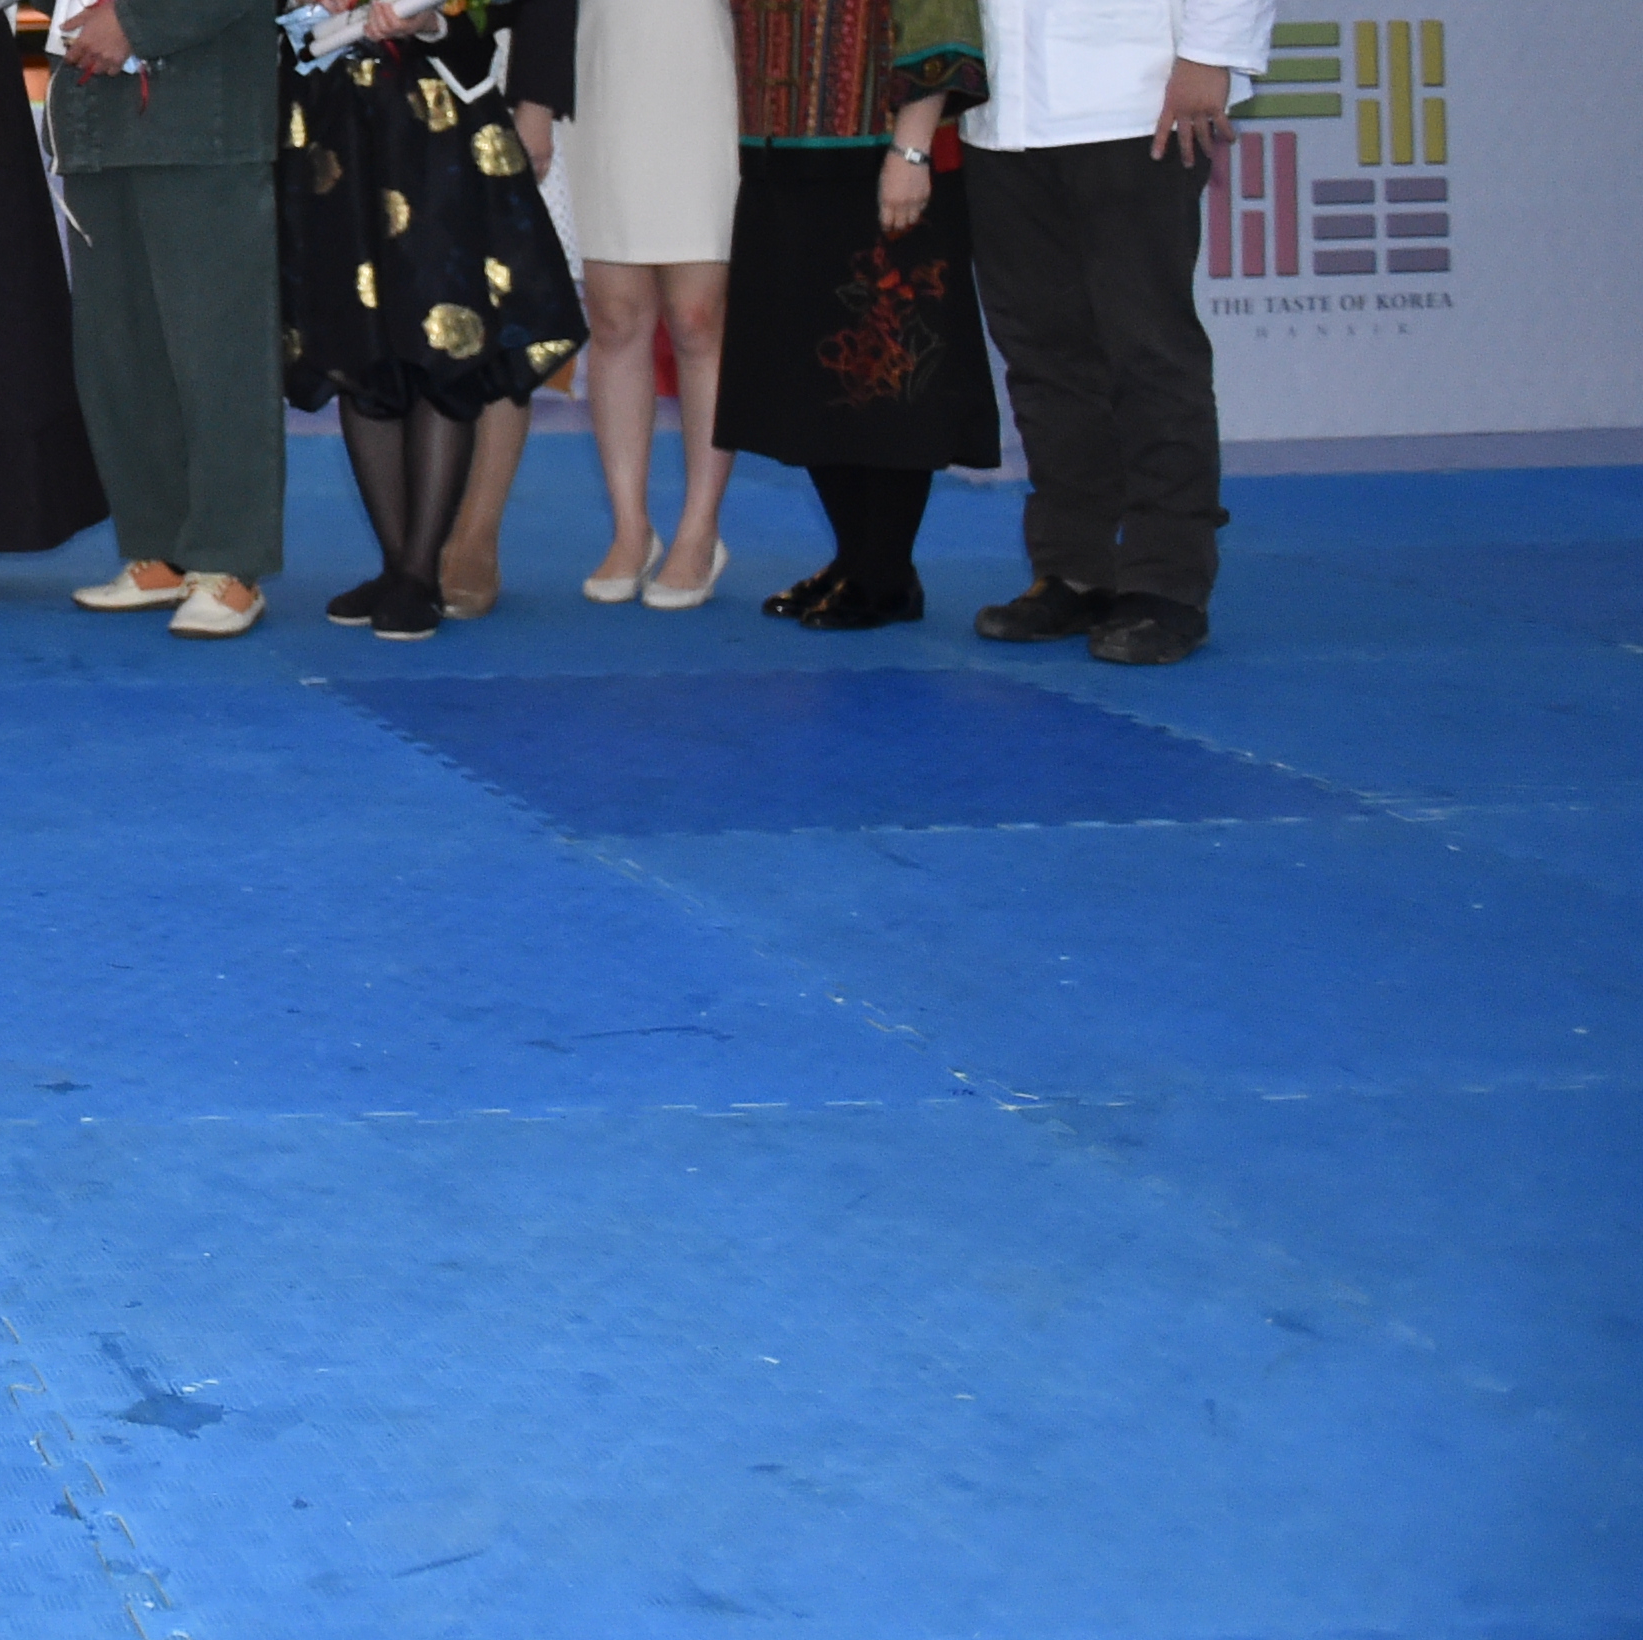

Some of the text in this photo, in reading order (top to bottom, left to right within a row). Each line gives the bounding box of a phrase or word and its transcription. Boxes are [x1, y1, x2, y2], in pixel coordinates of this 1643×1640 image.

[1210, 292, 1453, 315] THE TASTE OF KOREA
